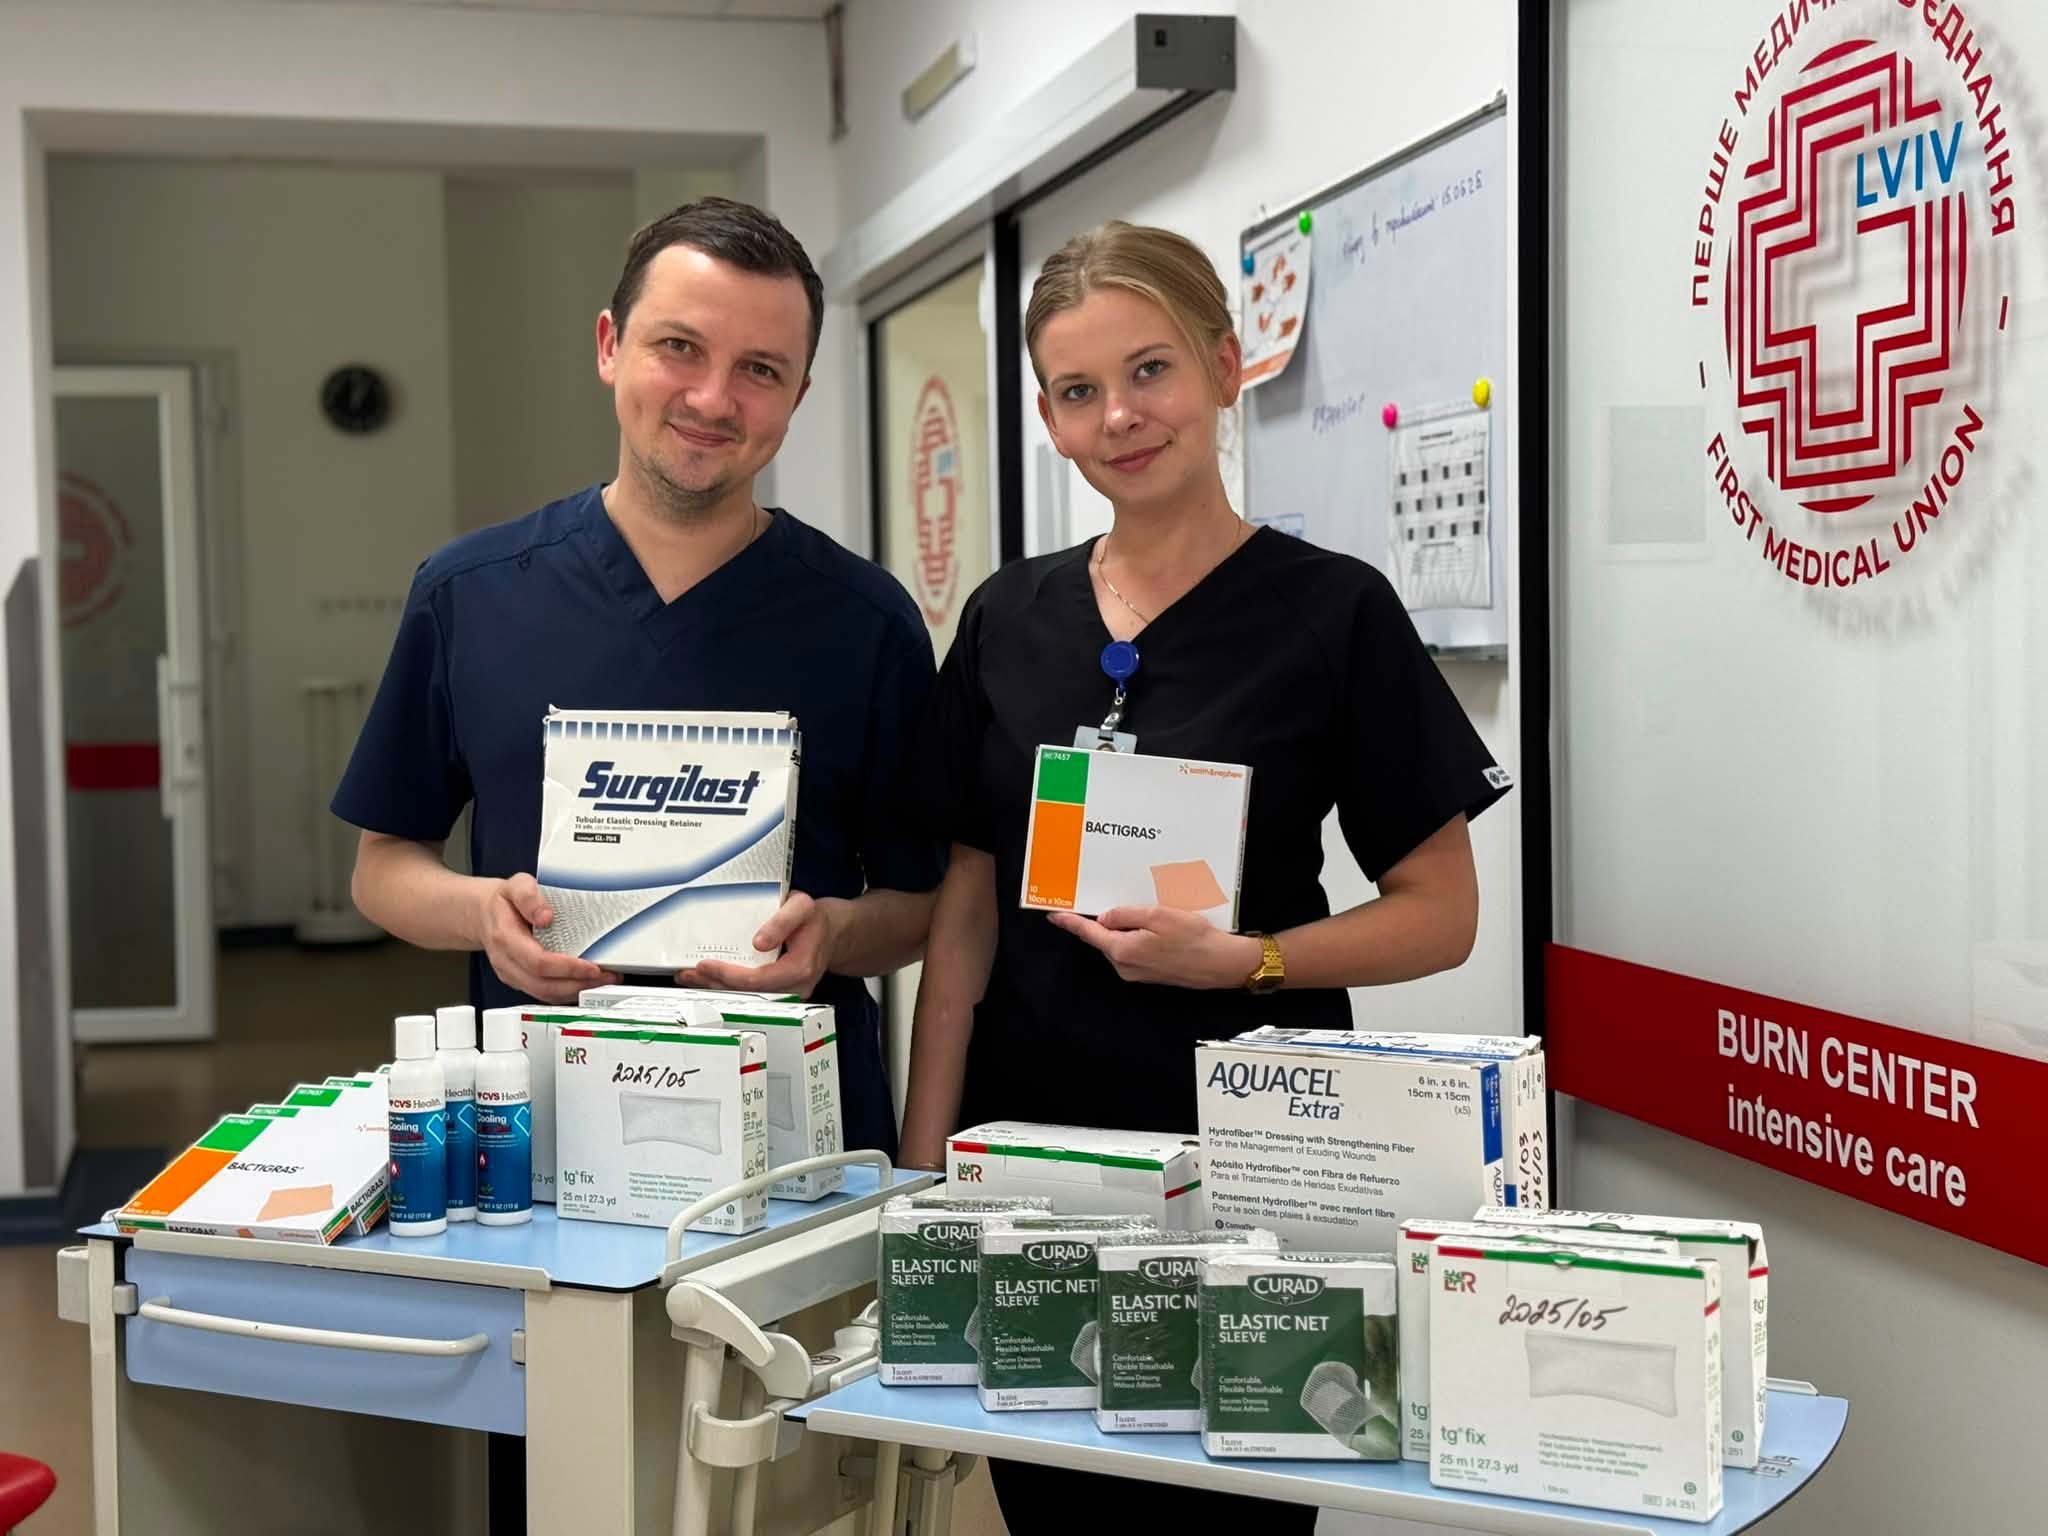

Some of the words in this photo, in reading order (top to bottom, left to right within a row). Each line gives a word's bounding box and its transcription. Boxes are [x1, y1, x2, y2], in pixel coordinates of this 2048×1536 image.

[1692, 118, 1739, 306] ПЕРШЕ
[1734, 0, 1837, 116] МЕДИ
[1856, 121, 1963, 207] LVIV
[1706, 432, 1763, 540] FIRST
[1763, 524, 1890, 588] MEDICAL
[1894, 404, 1985, 553] UNION
[578, 761, 761, 813] Surgilast
[575, 815, 604, 824] Tubular
[606, 816, 632, 825] Elastic
[633, 818, 667, 828] Dressing
[669, 819, 702, 828] Retainer
[820, 1058, 831, 1072] fix
[1718, 1008, 1809, 1080] BURN
[1820, 1036, 1980, 1129] CENTER
[612, 1062, 700, 1089] 2025/05
[1418, 1076, 1425, 1085] 6
[1427, 1077, 1439, 1087] in.
[1449, 1079, 1456, 1088] 6
[1458, 1080, 1470, 1089] in.
[482, 1091, 500, 1101] CVS
[753, 1087, 764, 1101] fix
[1408, 1088, 1434, 1099] 15cm
[1435, 1092, 1442, 1100] x
[1444, 1091, 1471, 1102] 15cm
[394, 1099, 411, 1108] CVS
[1454, 1105, 1472, 1117] (x5)
[1209, 1138, 1224, 1147] For
[1225, 1140, 1238, 1149] the
[1240, 1141, 1294, 1154] Management
[1295, 1146, 1304, 1155] of
[1306, 1147, 1340, 1160] Exuding
[1341, 1149, 1377, 1162] Wounds
[1265, 1131, 1304, 1144] Dressing
[1306, 1135, 1326, 1145] with
[1327, 1137, 1390, 1152] Strengthening
[1391, 1143, 1416, 1154] Fiber
[1727, 1083, 1874, 1177] intensive
[1885, 1146, 1967, 1208] care
[580, 1171, 595, 1185] fix
[1210, 1159, 1244, 1172] Apósito
[1302, 1169, 1320, 1177] con
[1321, 1169, 1344, 1180] Fibra
[1346, 1171, 1358, 1181] de
[1359, 1173, 1400, 1186] Refuerzo
[1210, 1170, 1230, 1180] Para
[1241, 1173, 1289, 1186] Tratamiento
[1290, 1177, 1302, 1188] de
[1338, 1182, 1384, 1196] Exudativas
[563, 1192, 573, 1201] 25
[589, 1194, 605, 1204] 27.3
[607, 1196, 617, 1206] yd
[1211, 1190, 1261, 1204] Pansement
[1319, 1204, 1341, 1213] avec
[1342, 1204, 1373, 1216] renfort
[1374, 1208, 1396, 1219] fibre
[1212, 1203, 1232, 1213] Pour
[1233, 1205, 1241, 1213] le
[1242, 1206, 1260, 1216] soin
[1261, 1208, 1278, 1218] des
[1279, 1210, 1304, 1221] plaies
[1305, 1212, 1311, 1221] à
[1312, 1214, 1359, 1226] exsudation
[1028, 1245, 1088, 1261] CURAD
[891, 1259, 957, 1273] ELASTIC
[891, 1274, 935, 1285] SLEEVE
[995, 1279, 1063, 1294] ELASTIC
[1066, 1279, 1098, 1293] NET
[1253, 1277, 1319, 1295] CURAD
[995, 1296, 1040, 1306] SLEEVE
[1112, 1295, 1181, 1310] ELASTIC
[1112, 1312, 1158, 1323] SLEEVE
[1499, 1294, 1628, 1331] 2025/05
[1219, 1314, 1291, 1330] ELASTIC
[1295, 1315, 1329, 1331] NET
[1219, 1331, 1267, 1343] SLEEVE
[1410, 1428, 1424, 1440] 25
[1464, 1427, 1487, 1446] fix
[1439, 1453, 1453, 1465] 25
[1456, 1456, 1467, 1466] m
[1477, 1458, 1501, 1472] 27.3
[1503, 1462, 1519, 1475] yd
